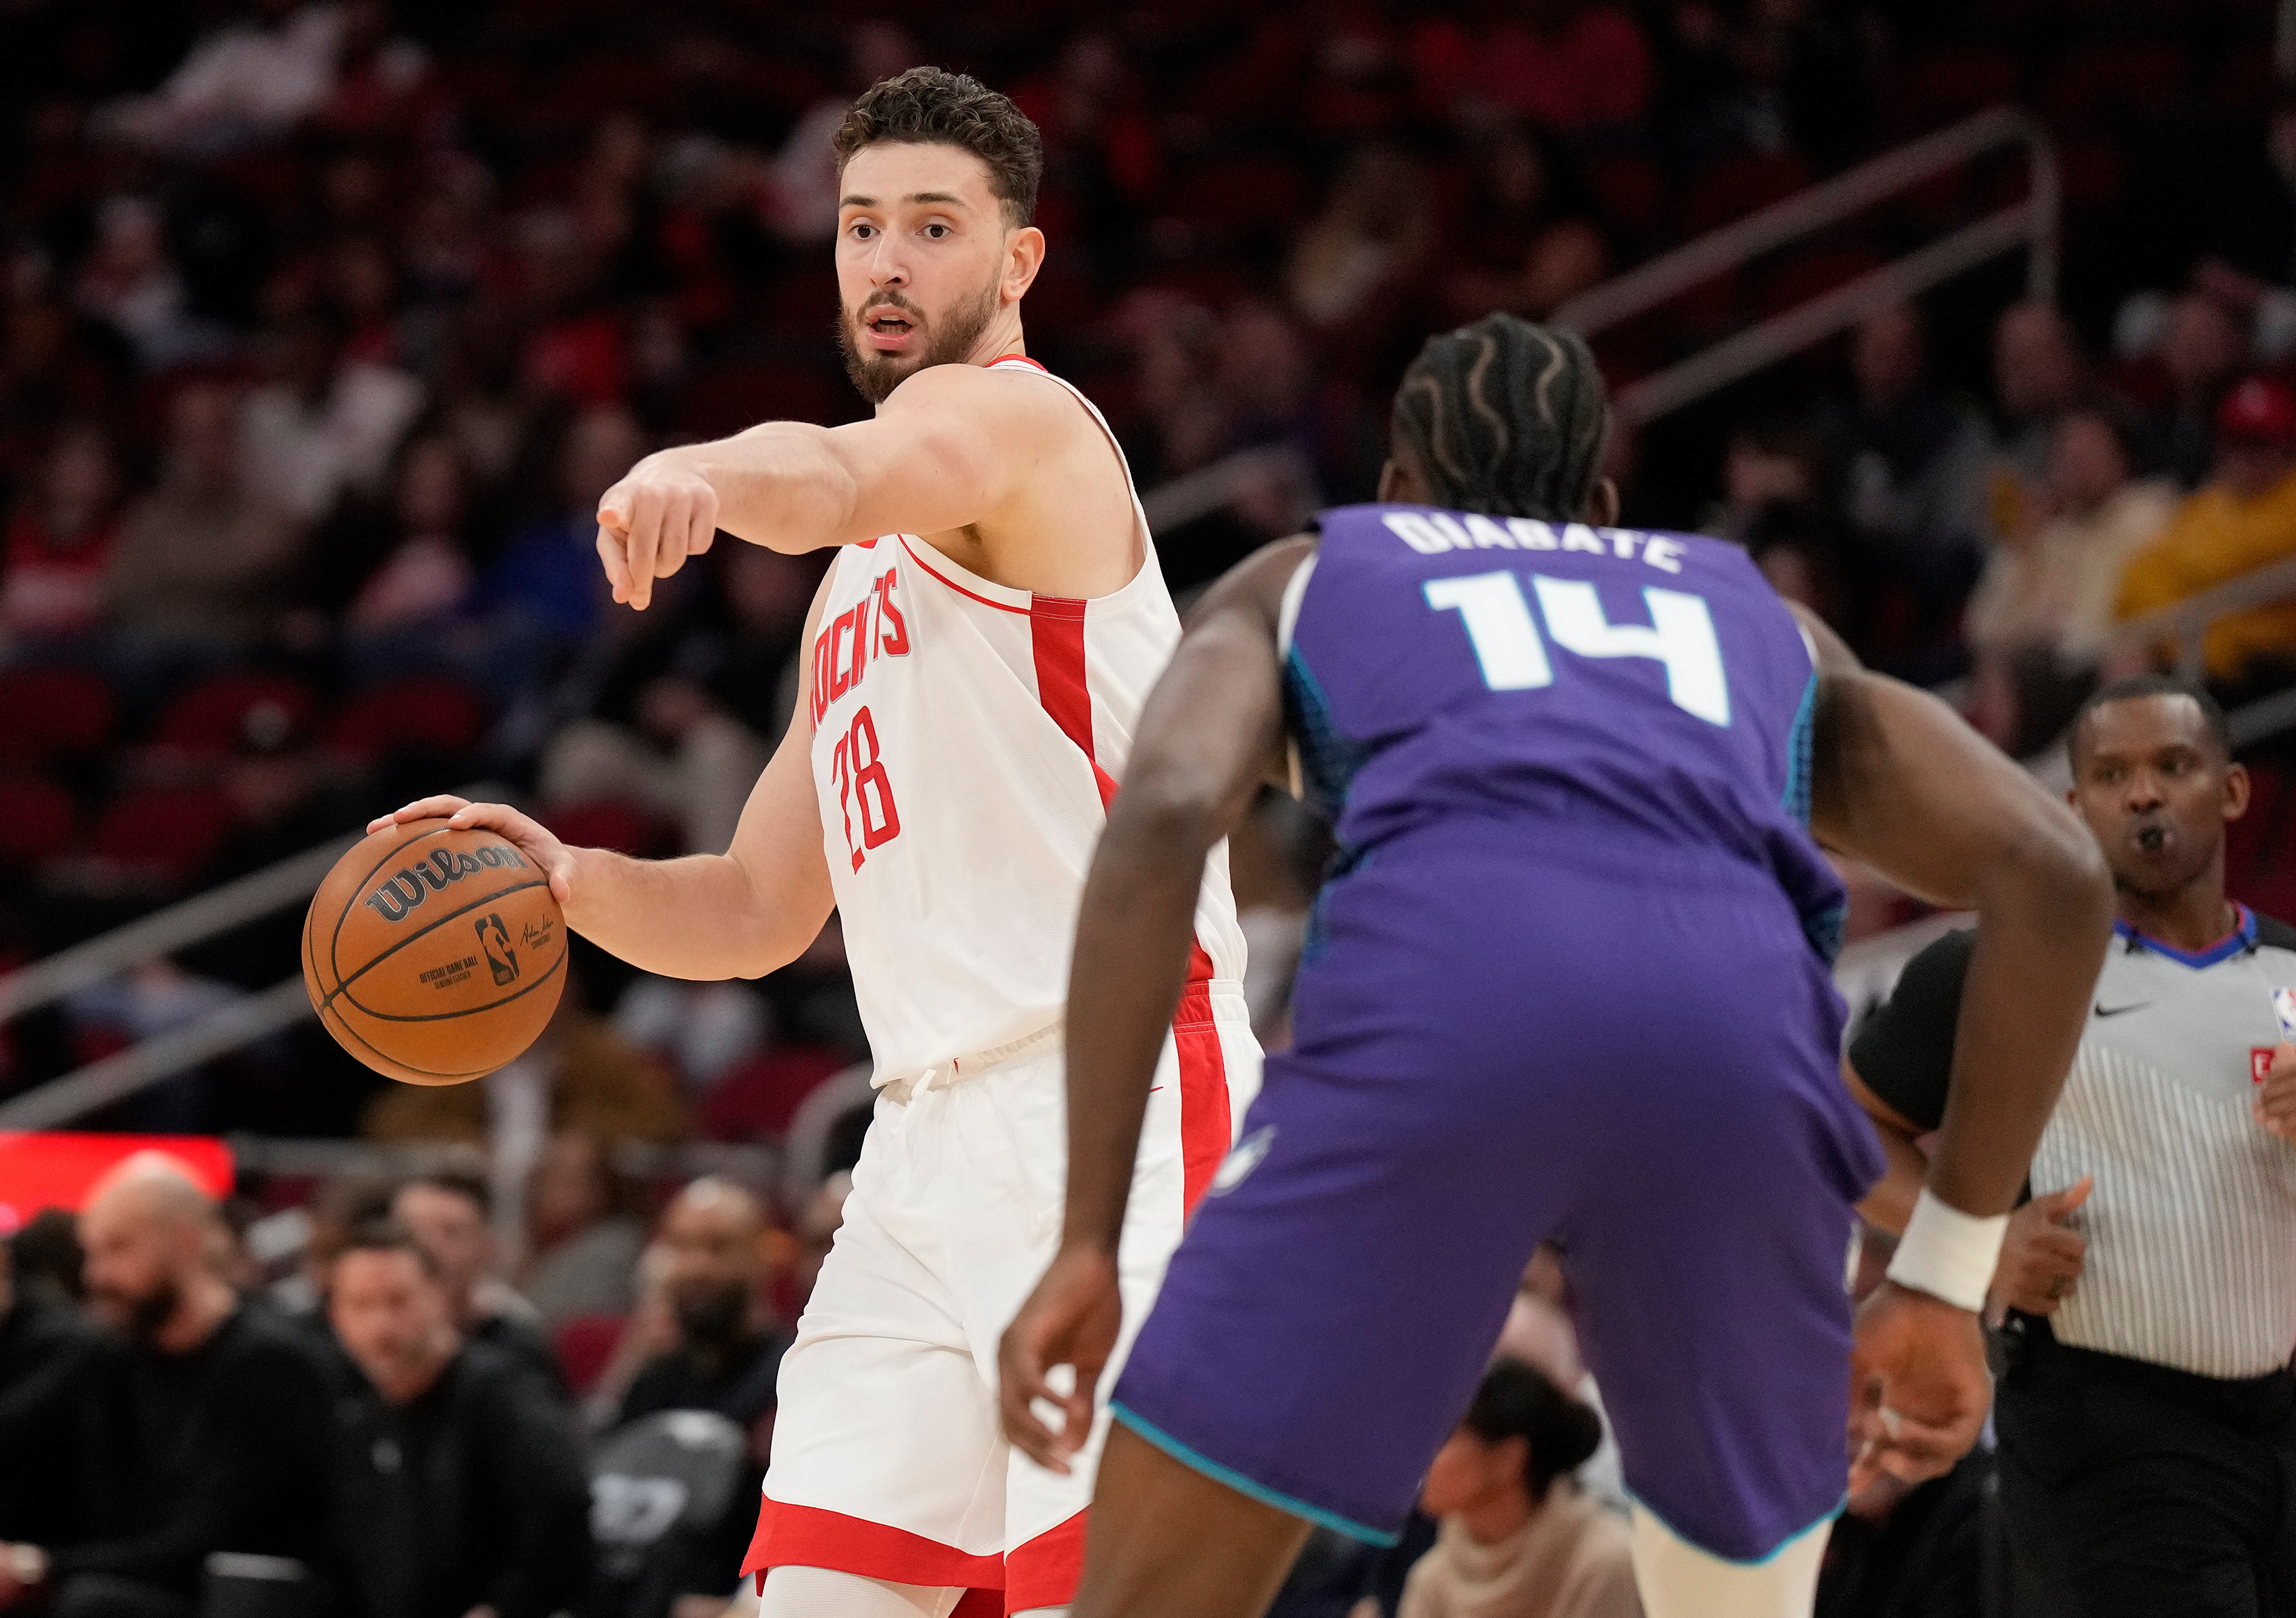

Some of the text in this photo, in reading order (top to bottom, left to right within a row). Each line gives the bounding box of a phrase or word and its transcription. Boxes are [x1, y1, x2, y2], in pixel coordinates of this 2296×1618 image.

[1382, 511, 1687, 575] DIABATE
[810, 566, 911, 740] OCKTS
[1422, 570, 1731, 728] 14
[831, 705, 900, 875] 28
[364, 846, 529, 923] Wilson
[420, 955, 479, 984] OFFICIAL GAME BALL
